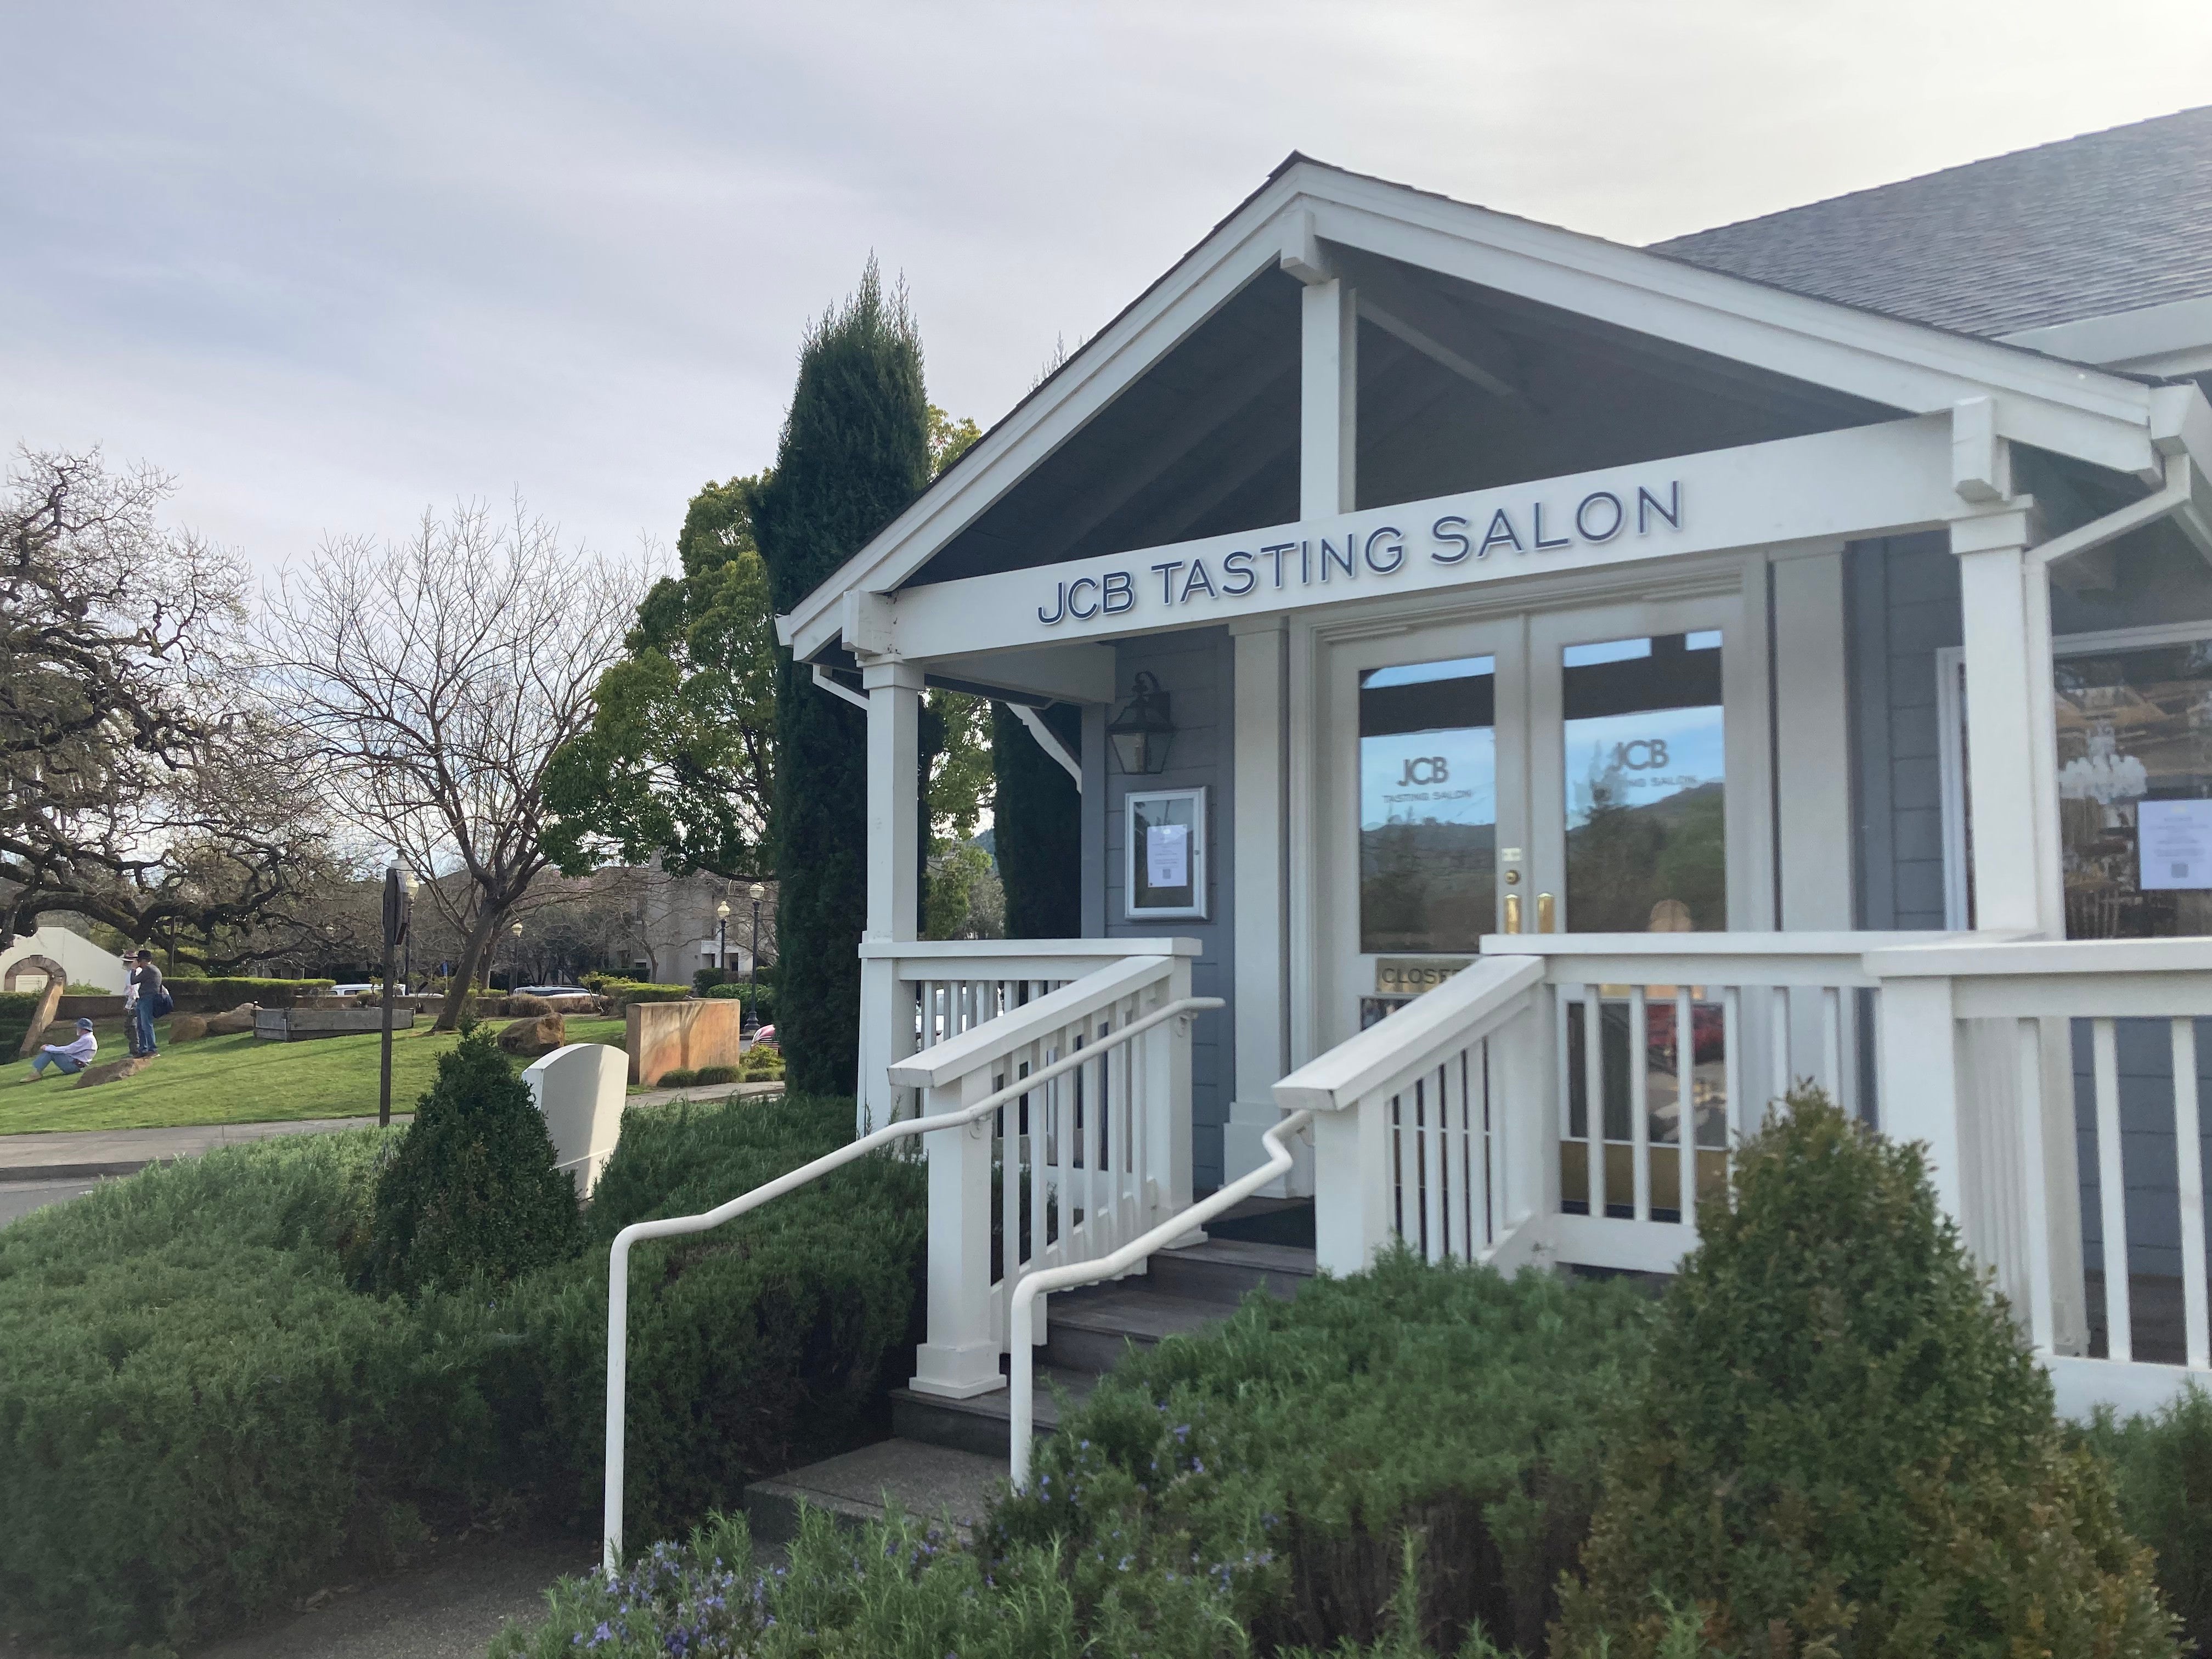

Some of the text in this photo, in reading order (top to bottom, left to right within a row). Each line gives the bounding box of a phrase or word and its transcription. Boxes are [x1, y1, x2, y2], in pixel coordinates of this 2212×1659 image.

[1037, 479, 1681, 624] JCB TASTING SALON
[1396, 756, 1449, 786] JCB
[1605, 738, 1669, 771] JCB
